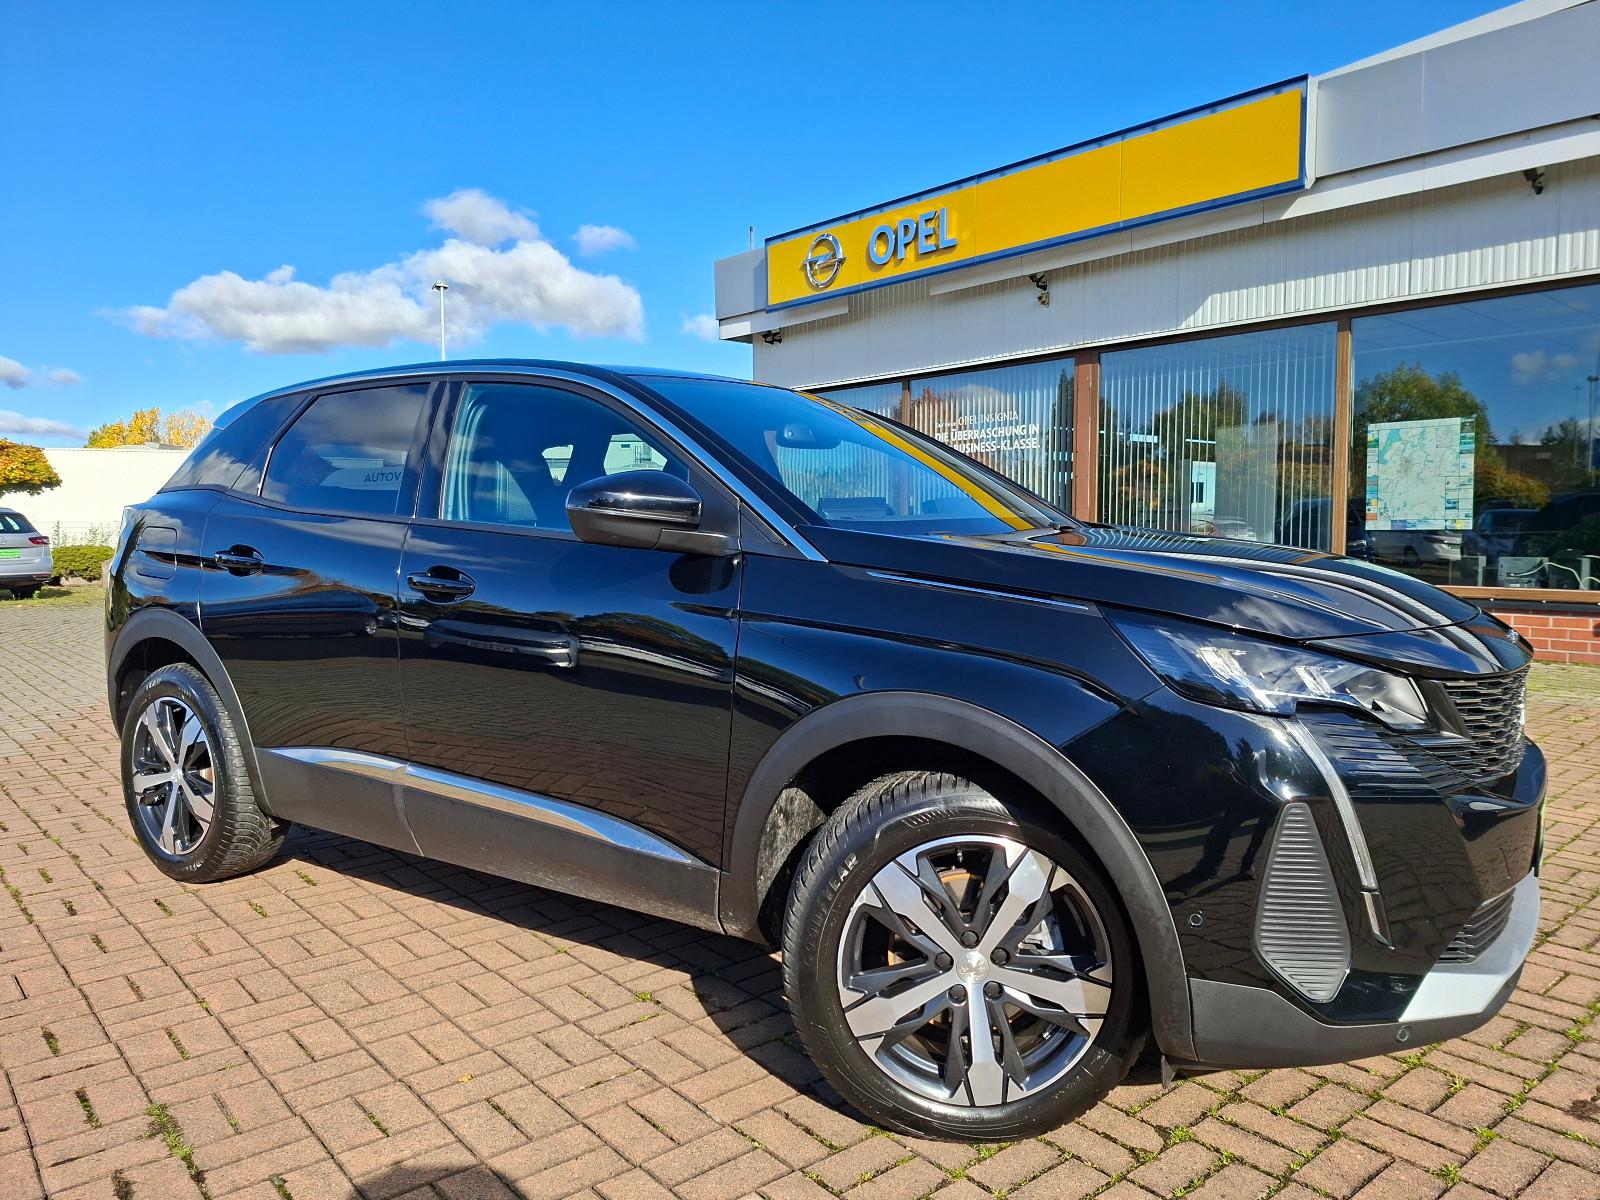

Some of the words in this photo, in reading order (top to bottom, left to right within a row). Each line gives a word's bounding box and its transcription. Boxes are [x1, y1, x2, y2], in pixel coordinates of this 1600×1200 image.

[869, 207, 957, 265] OPEL
[958, 414, 977, 426] OPEL
[980, 410, 1019, 424] INSIGNIA
[935, 431, 948, 442] DIE
[951, 425, 1027, 442] ÜBERRASCHUNG
[1029, 423, 1040, 435] IN
